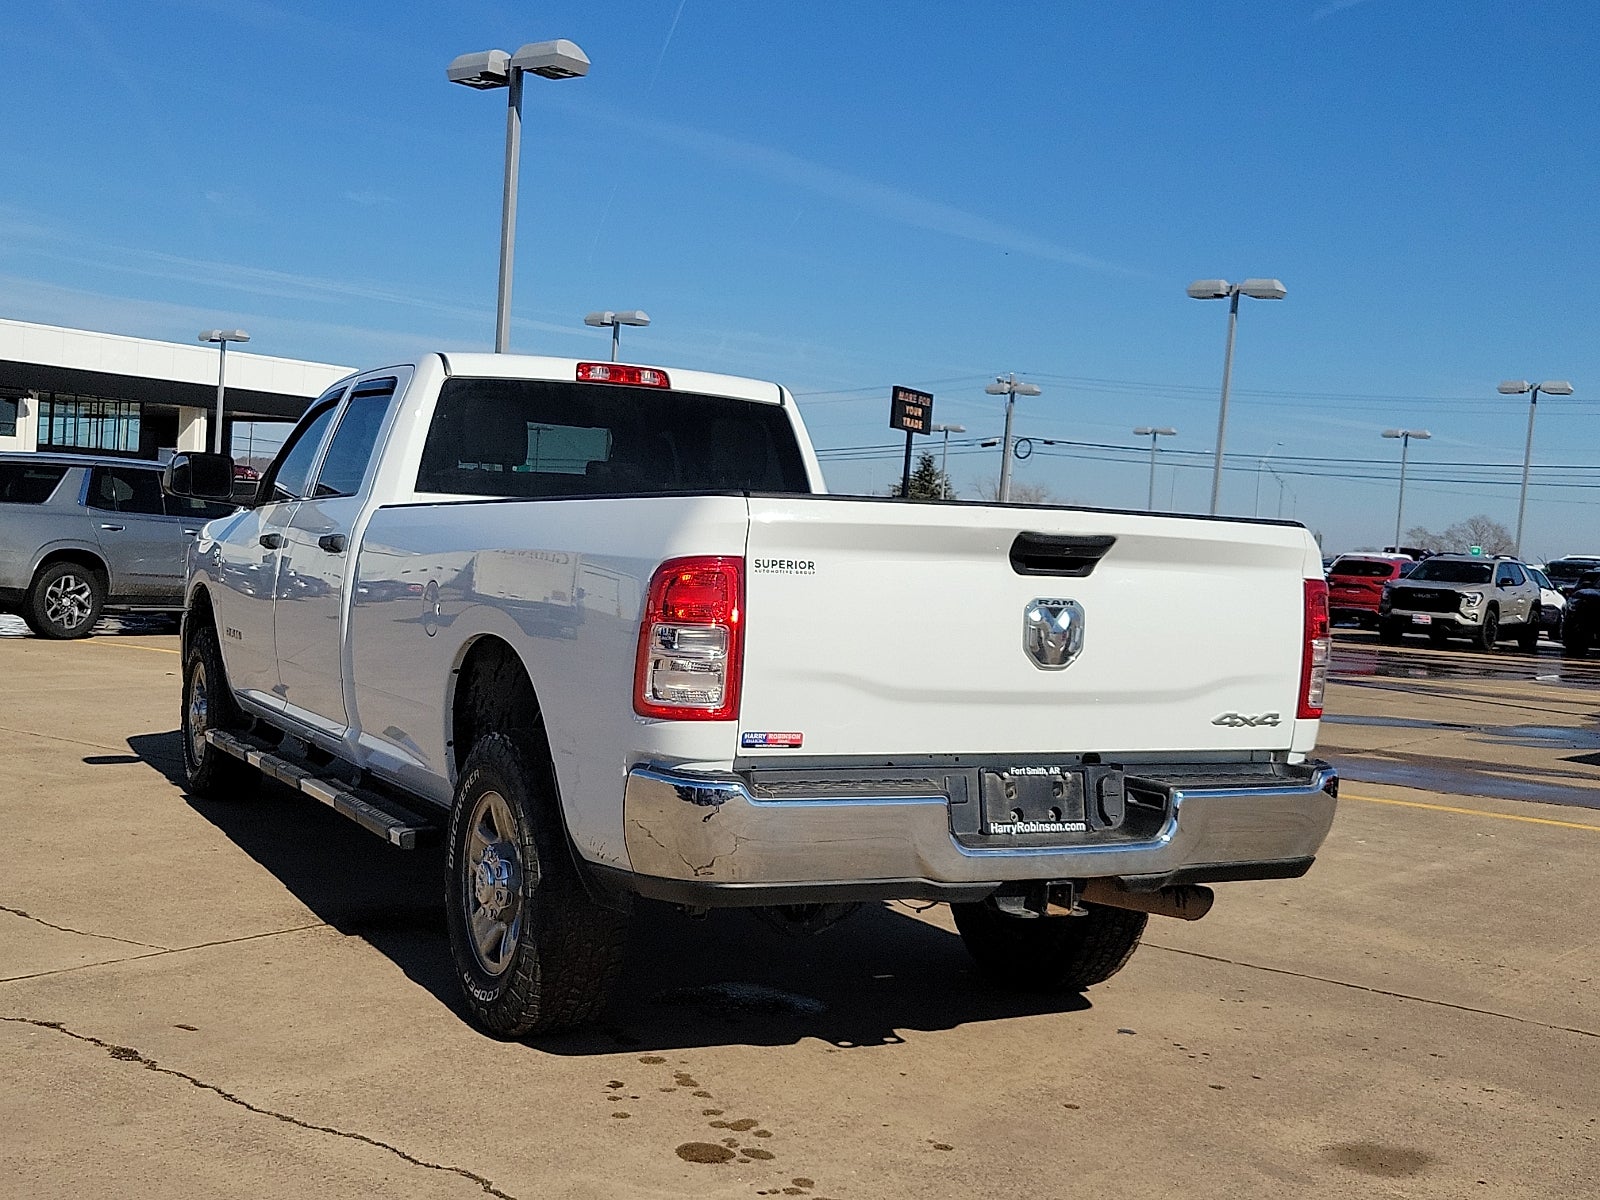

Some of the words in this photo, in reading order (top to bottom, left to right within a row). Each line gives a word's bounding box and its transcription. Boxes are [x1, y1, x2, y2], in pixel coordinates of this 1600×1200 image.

[905, 405, 923, 417] YOUR
[902, 417, 923, 430] TRADE
[754, 559, 815, 570] SUPERIOR
[1010, 767, 1025, 775] Fort
[1026, 766, 1048, 776] Smith,
[1049, 767, 1061, 775] AR
[448, 768, 480, 868] DISCOVERER
[990, 821, 1086, 835] HarryRobinson.com
[463, 972, 500, 1003] COOPER
